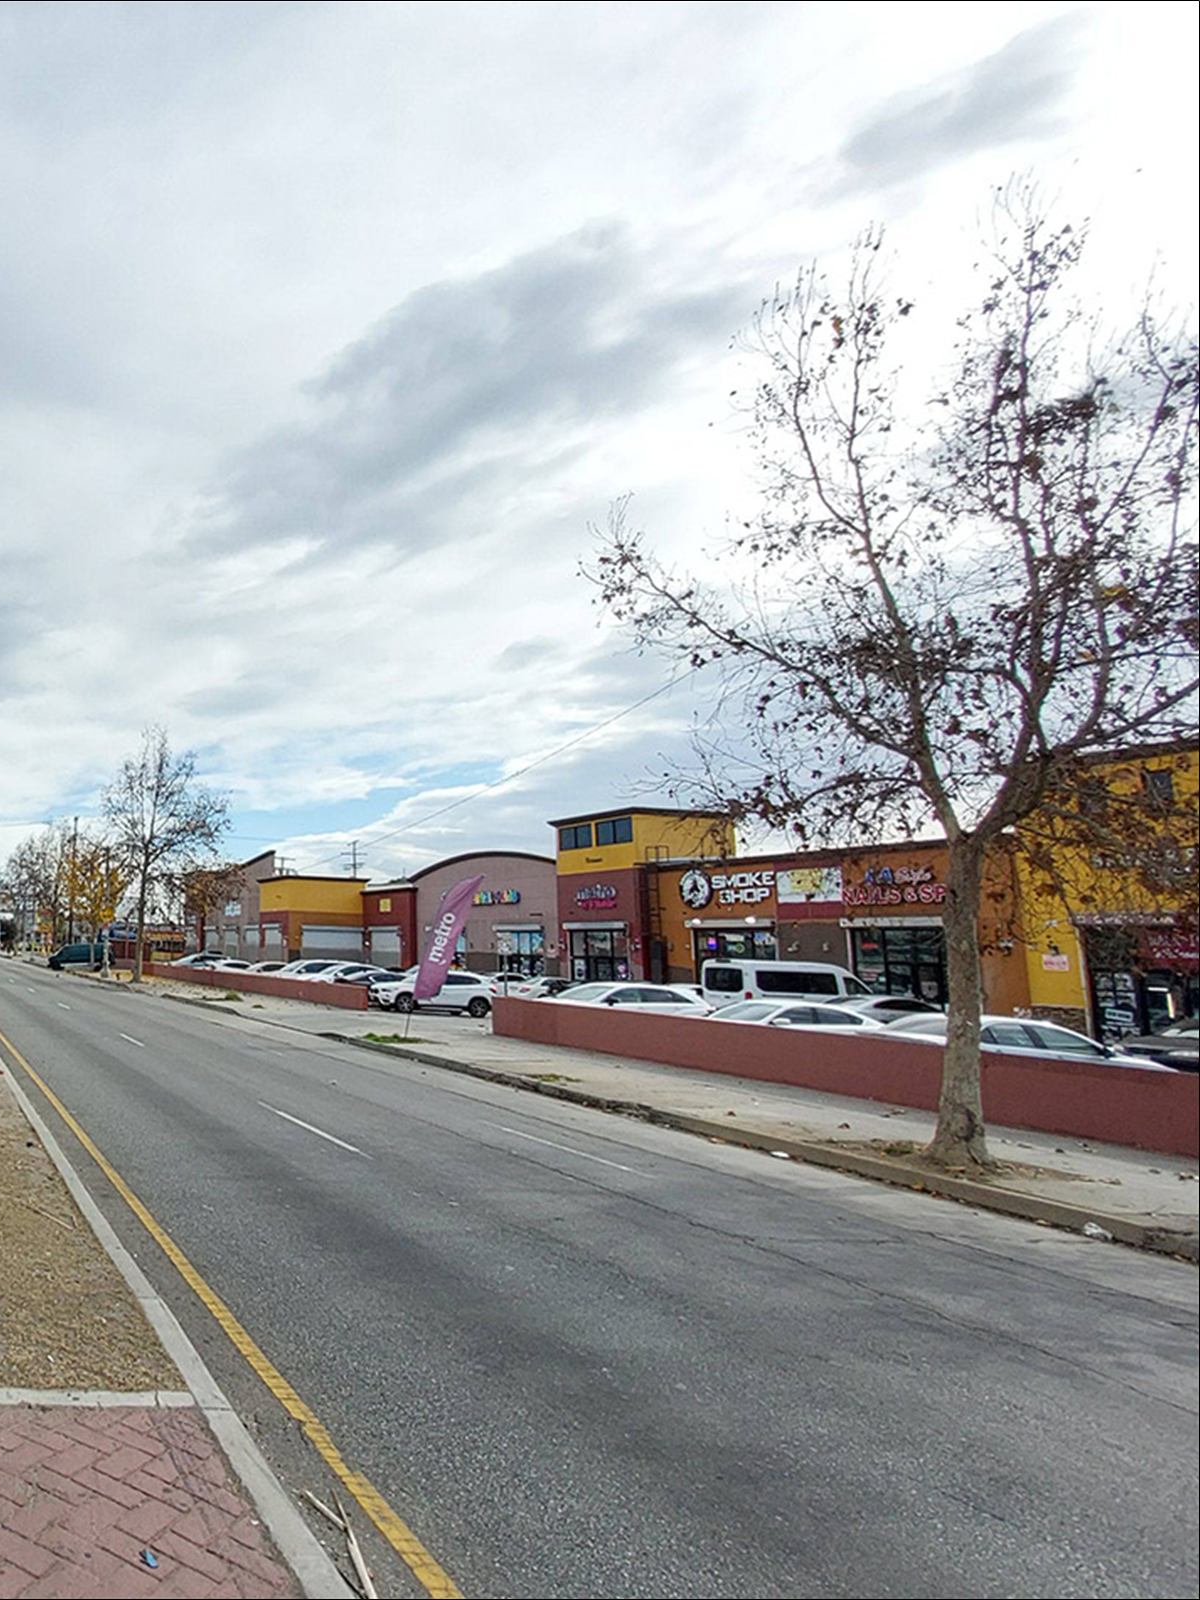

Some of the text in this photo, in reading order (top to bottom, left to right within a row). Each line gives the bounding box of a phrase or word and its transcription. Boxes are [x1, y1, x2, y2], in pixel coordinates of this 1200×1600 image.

[711, 871, 775, 889] SMOKE
[719, 888, 770, 904] SHOP
[842, 883, 948, 905] NAILS & SP
[428, 912, 456, 965] metro
